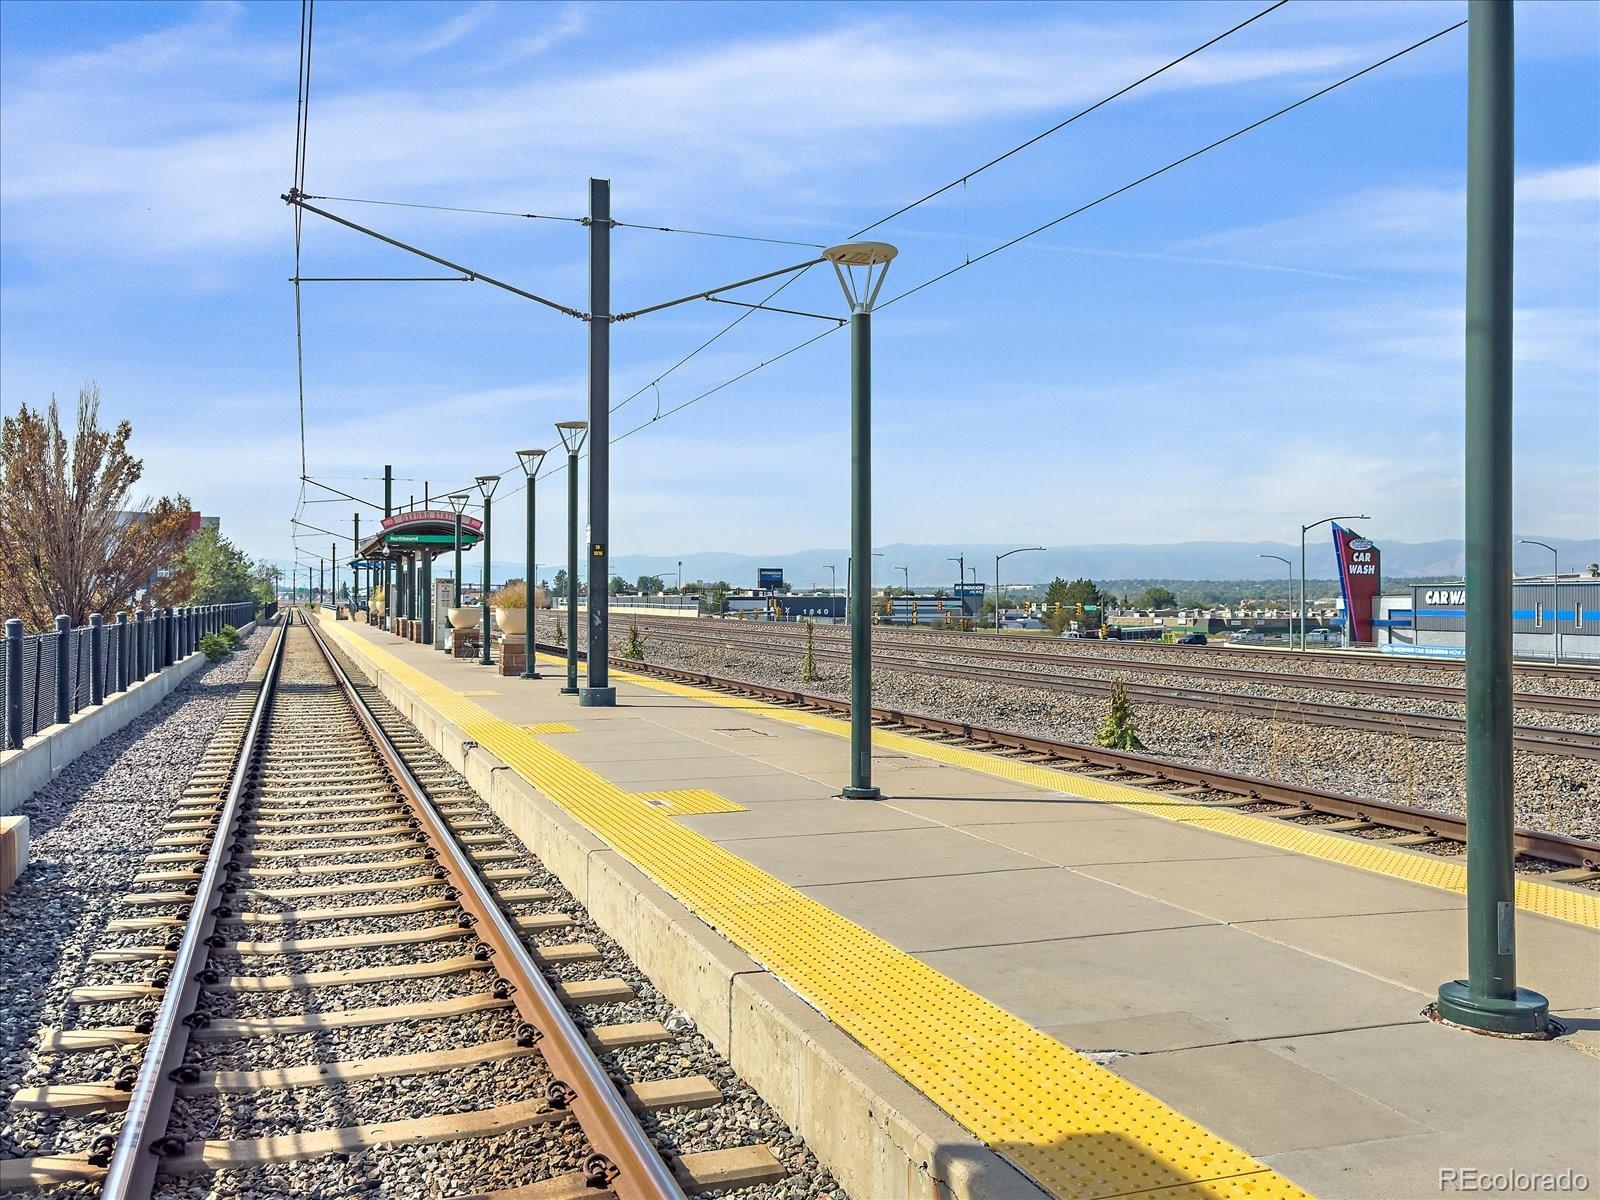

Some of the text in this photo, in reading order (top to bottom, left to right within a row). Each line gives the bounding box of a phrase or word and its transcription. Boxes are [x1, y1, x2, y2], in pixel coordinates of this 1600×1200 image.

[1353, 552, 1371, 562] CAR
[1349, 564, 1375, 575] WASH
[1425, 590, 1465, 605] CAR WA
